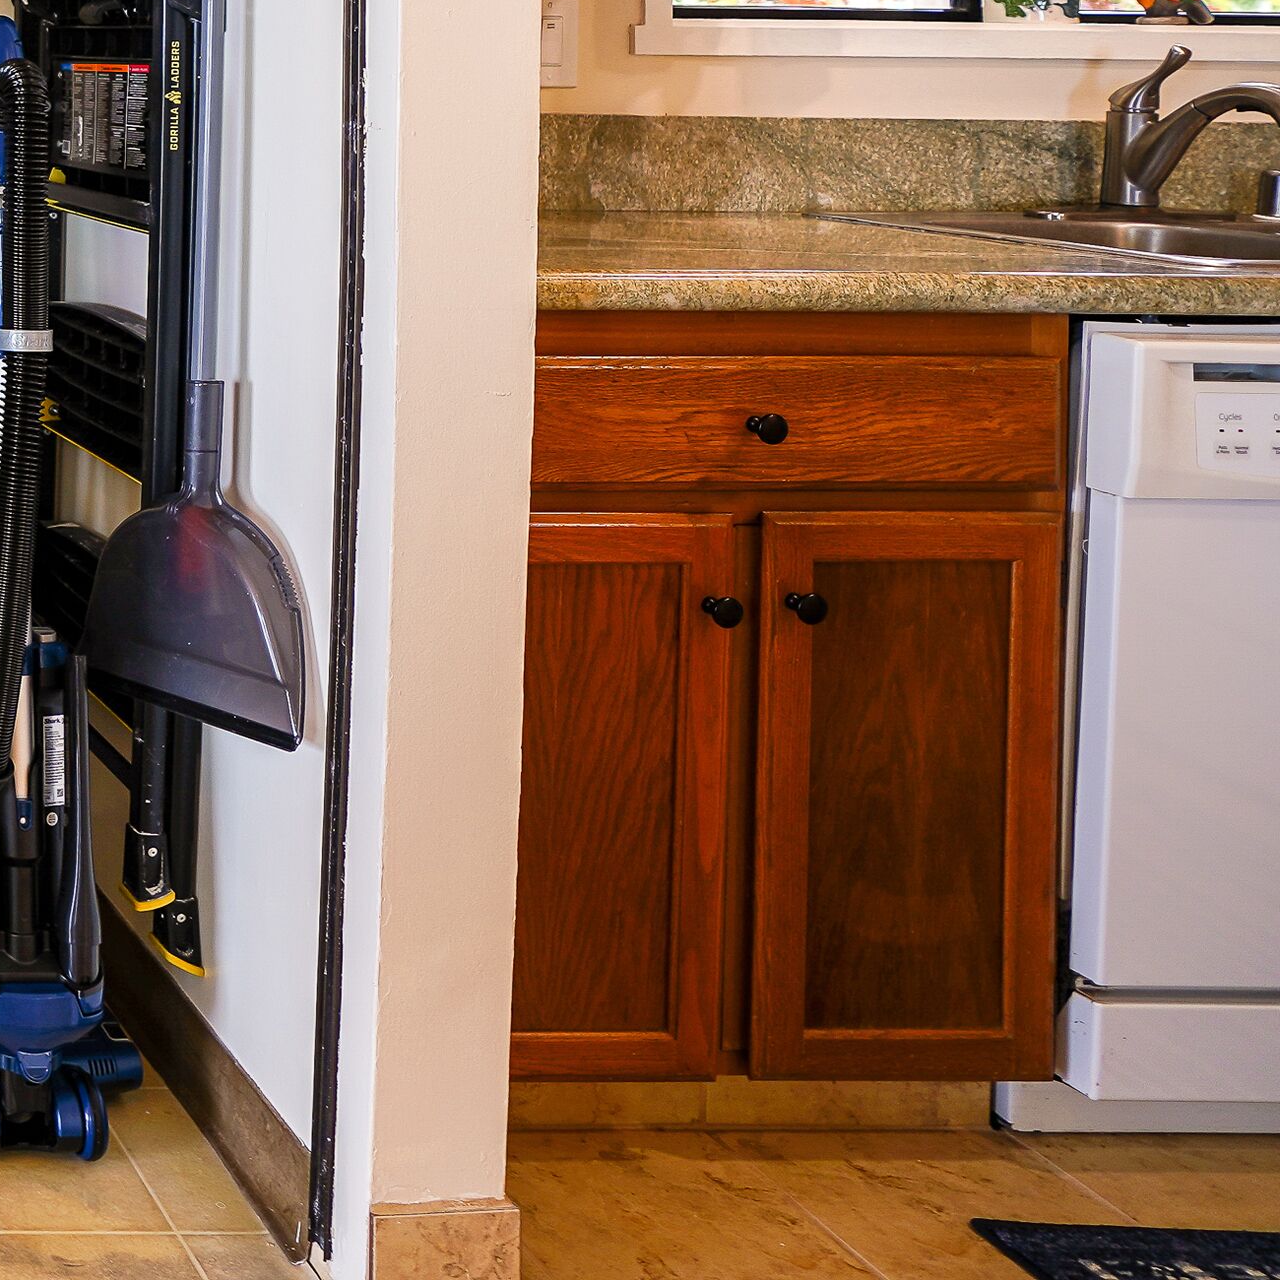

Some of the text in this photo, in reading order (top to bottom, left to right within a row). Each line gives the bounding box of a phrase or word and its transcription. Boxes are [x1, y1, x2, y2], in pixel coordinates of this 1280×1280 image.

[169, 40, 180, 151] GORILLA LADDERS
[1218, 413, 1242, 422] Cycles
